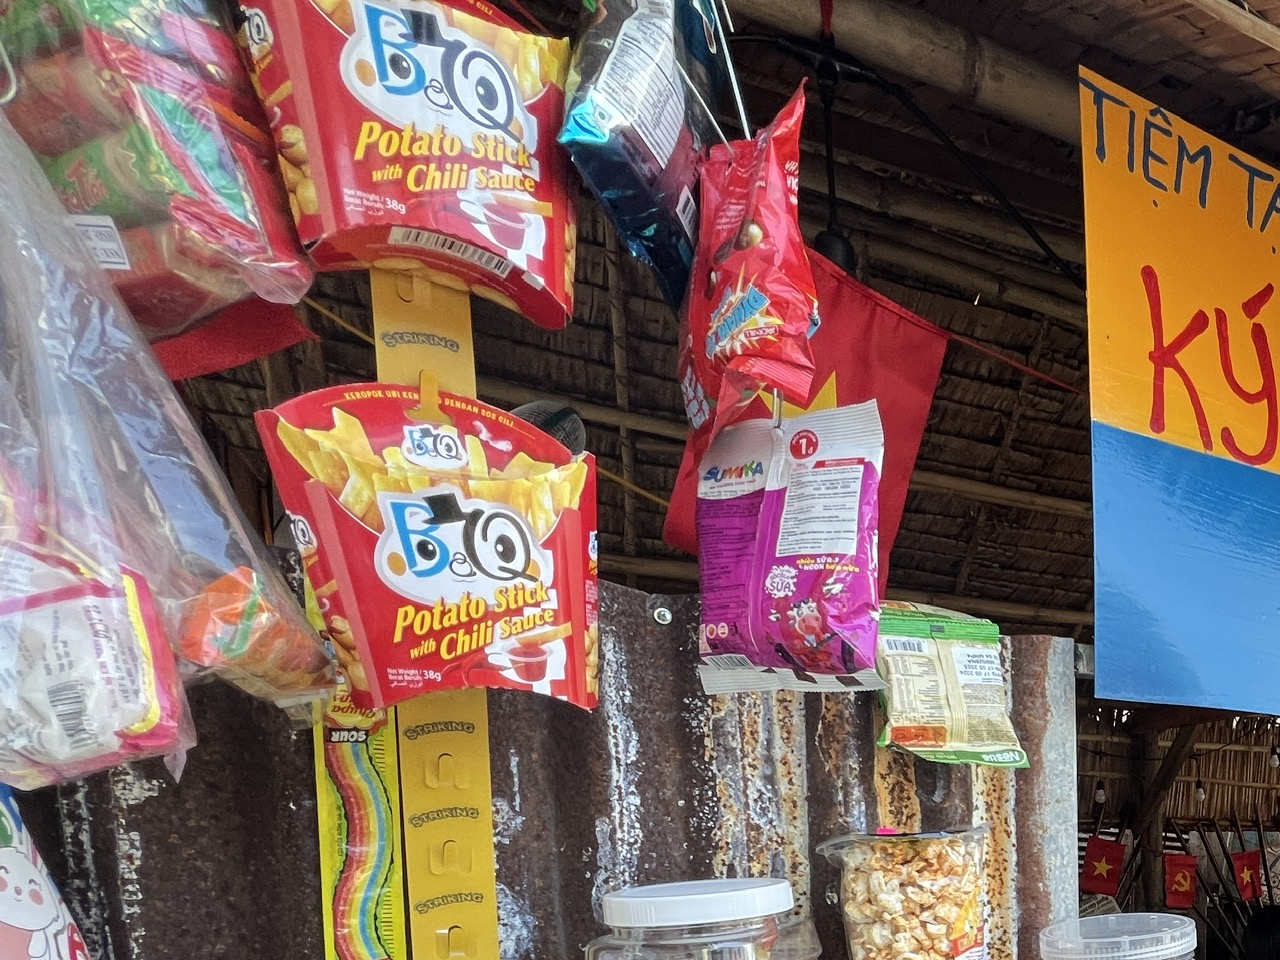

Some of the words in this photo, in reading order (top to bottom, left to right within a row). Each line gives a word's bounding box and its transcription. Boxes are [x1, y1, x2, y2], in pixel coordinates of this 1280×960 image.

[354, 120, 462, 160] Potato
[470, 130, 533, 168] Stick
[1079, 76, 1211, 208] TIỆM
[371, 164, 402, 182] with
[406, 163, 467, 192] Chili
[474, 166, 535, 191] Sauce
[384, 198, 406, 215] 38g
[381, 331, 460, 353] STRIKING
[1140, 264, 1280, 467] KÝ
[344, 390, 384, 401] KEROPOK
[385, 390, 400, 398] UBI
[444, 397, 478, 414] DENGAN
[480, 408, 497, 420] SOS
[498, 415, 514, 428] CILI
[703, 460, 764, 483] SUMIKA
[394, 596, 486, 642] Potato
[494, 581, 550, 613] Stick
[409, 640, 437, 659] with
[439, 627, 494, 660] Chili
[499, 607, 554, 639] Sauce
[421, 666, 442, 684] 38g
[330, 730, 366, 742] SOUR
[404, 720, 475, 740] STRIKING
[408, 807, 480, 828] STRIKING
[413, 892, 484, 915] STRIKING
